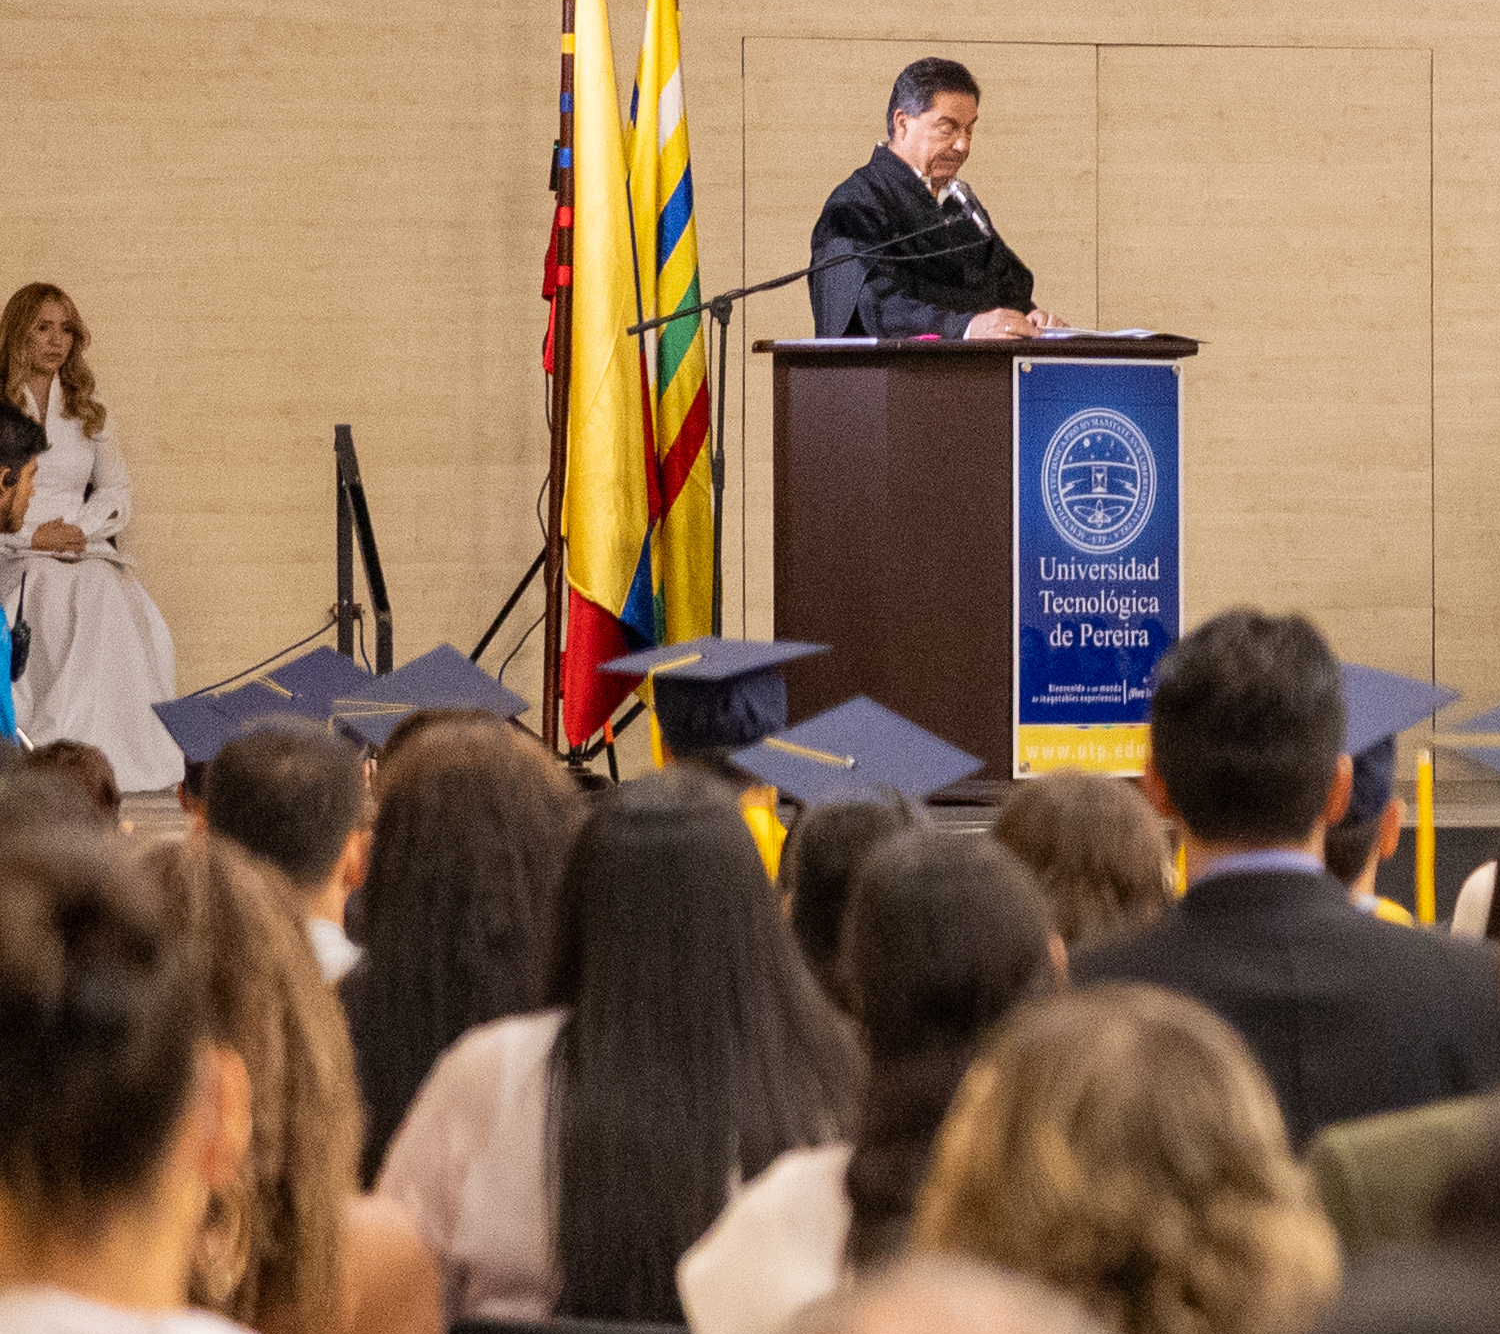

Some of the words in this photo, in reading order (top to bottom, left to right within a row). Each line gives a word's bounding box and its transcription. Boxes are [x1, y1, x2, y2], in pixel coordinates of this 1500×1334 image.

[1039, 556, 1160, 581] Universidad
[1039, 589, 1160, 619] Tecnológica
[1049, 622, 1074, 648] de
[1080, 623, 1150, 648] Pereira
